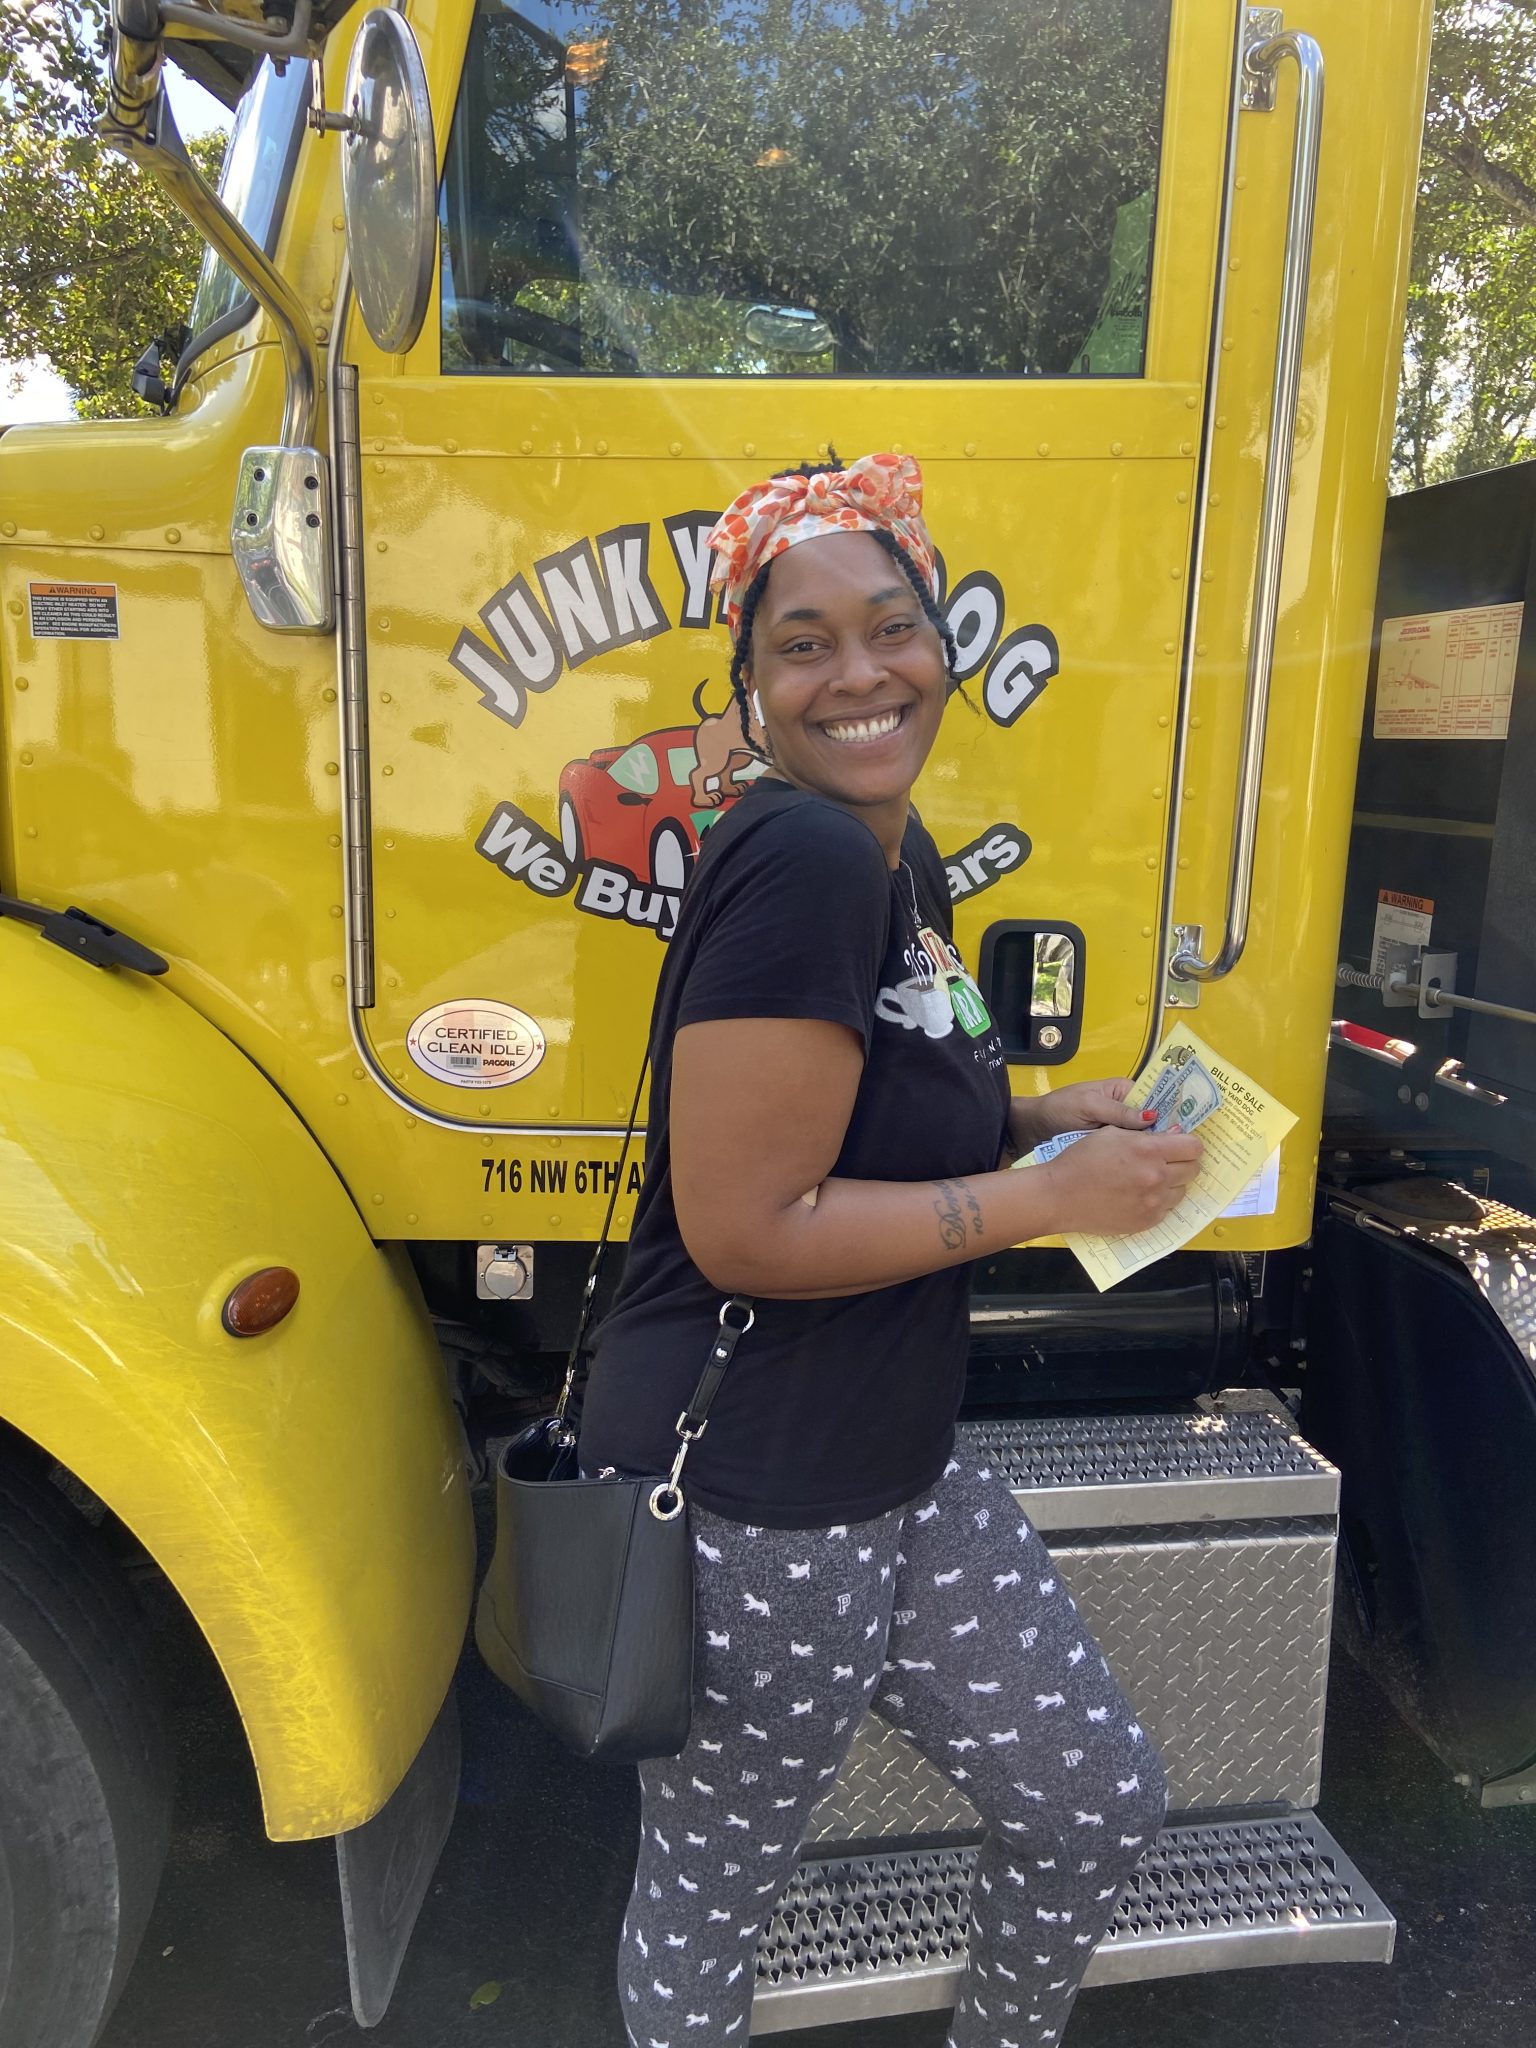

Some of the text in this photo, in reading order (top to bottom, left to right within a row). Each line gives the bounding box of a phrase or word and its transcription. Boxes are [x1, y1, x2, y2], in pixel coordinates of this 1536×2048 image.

[57, 586, 97, 595] WARNING
[453, 532, 663, 722] JUNK
[932, 566, 1054, 721] OG
[481, 811, 567, 891] We
[944, 833, 1021, 899] ars
[1391, 894, 1424, 910] WARNING
[435, 1027, 518, 1041] CERTIFIED
[427, 1042, 526, 1056] CLEAN IDLE
[483, 1059, 516, 1067] PACCAR
[1211, 1066, 1265, 1113] BILL OF SALE
[1227, 1091, 1243, 1106] YARD
[1241, 1104, 1254, 1116] DOG
[482, 1159, 649, 1195] 716 NW 6TH A
